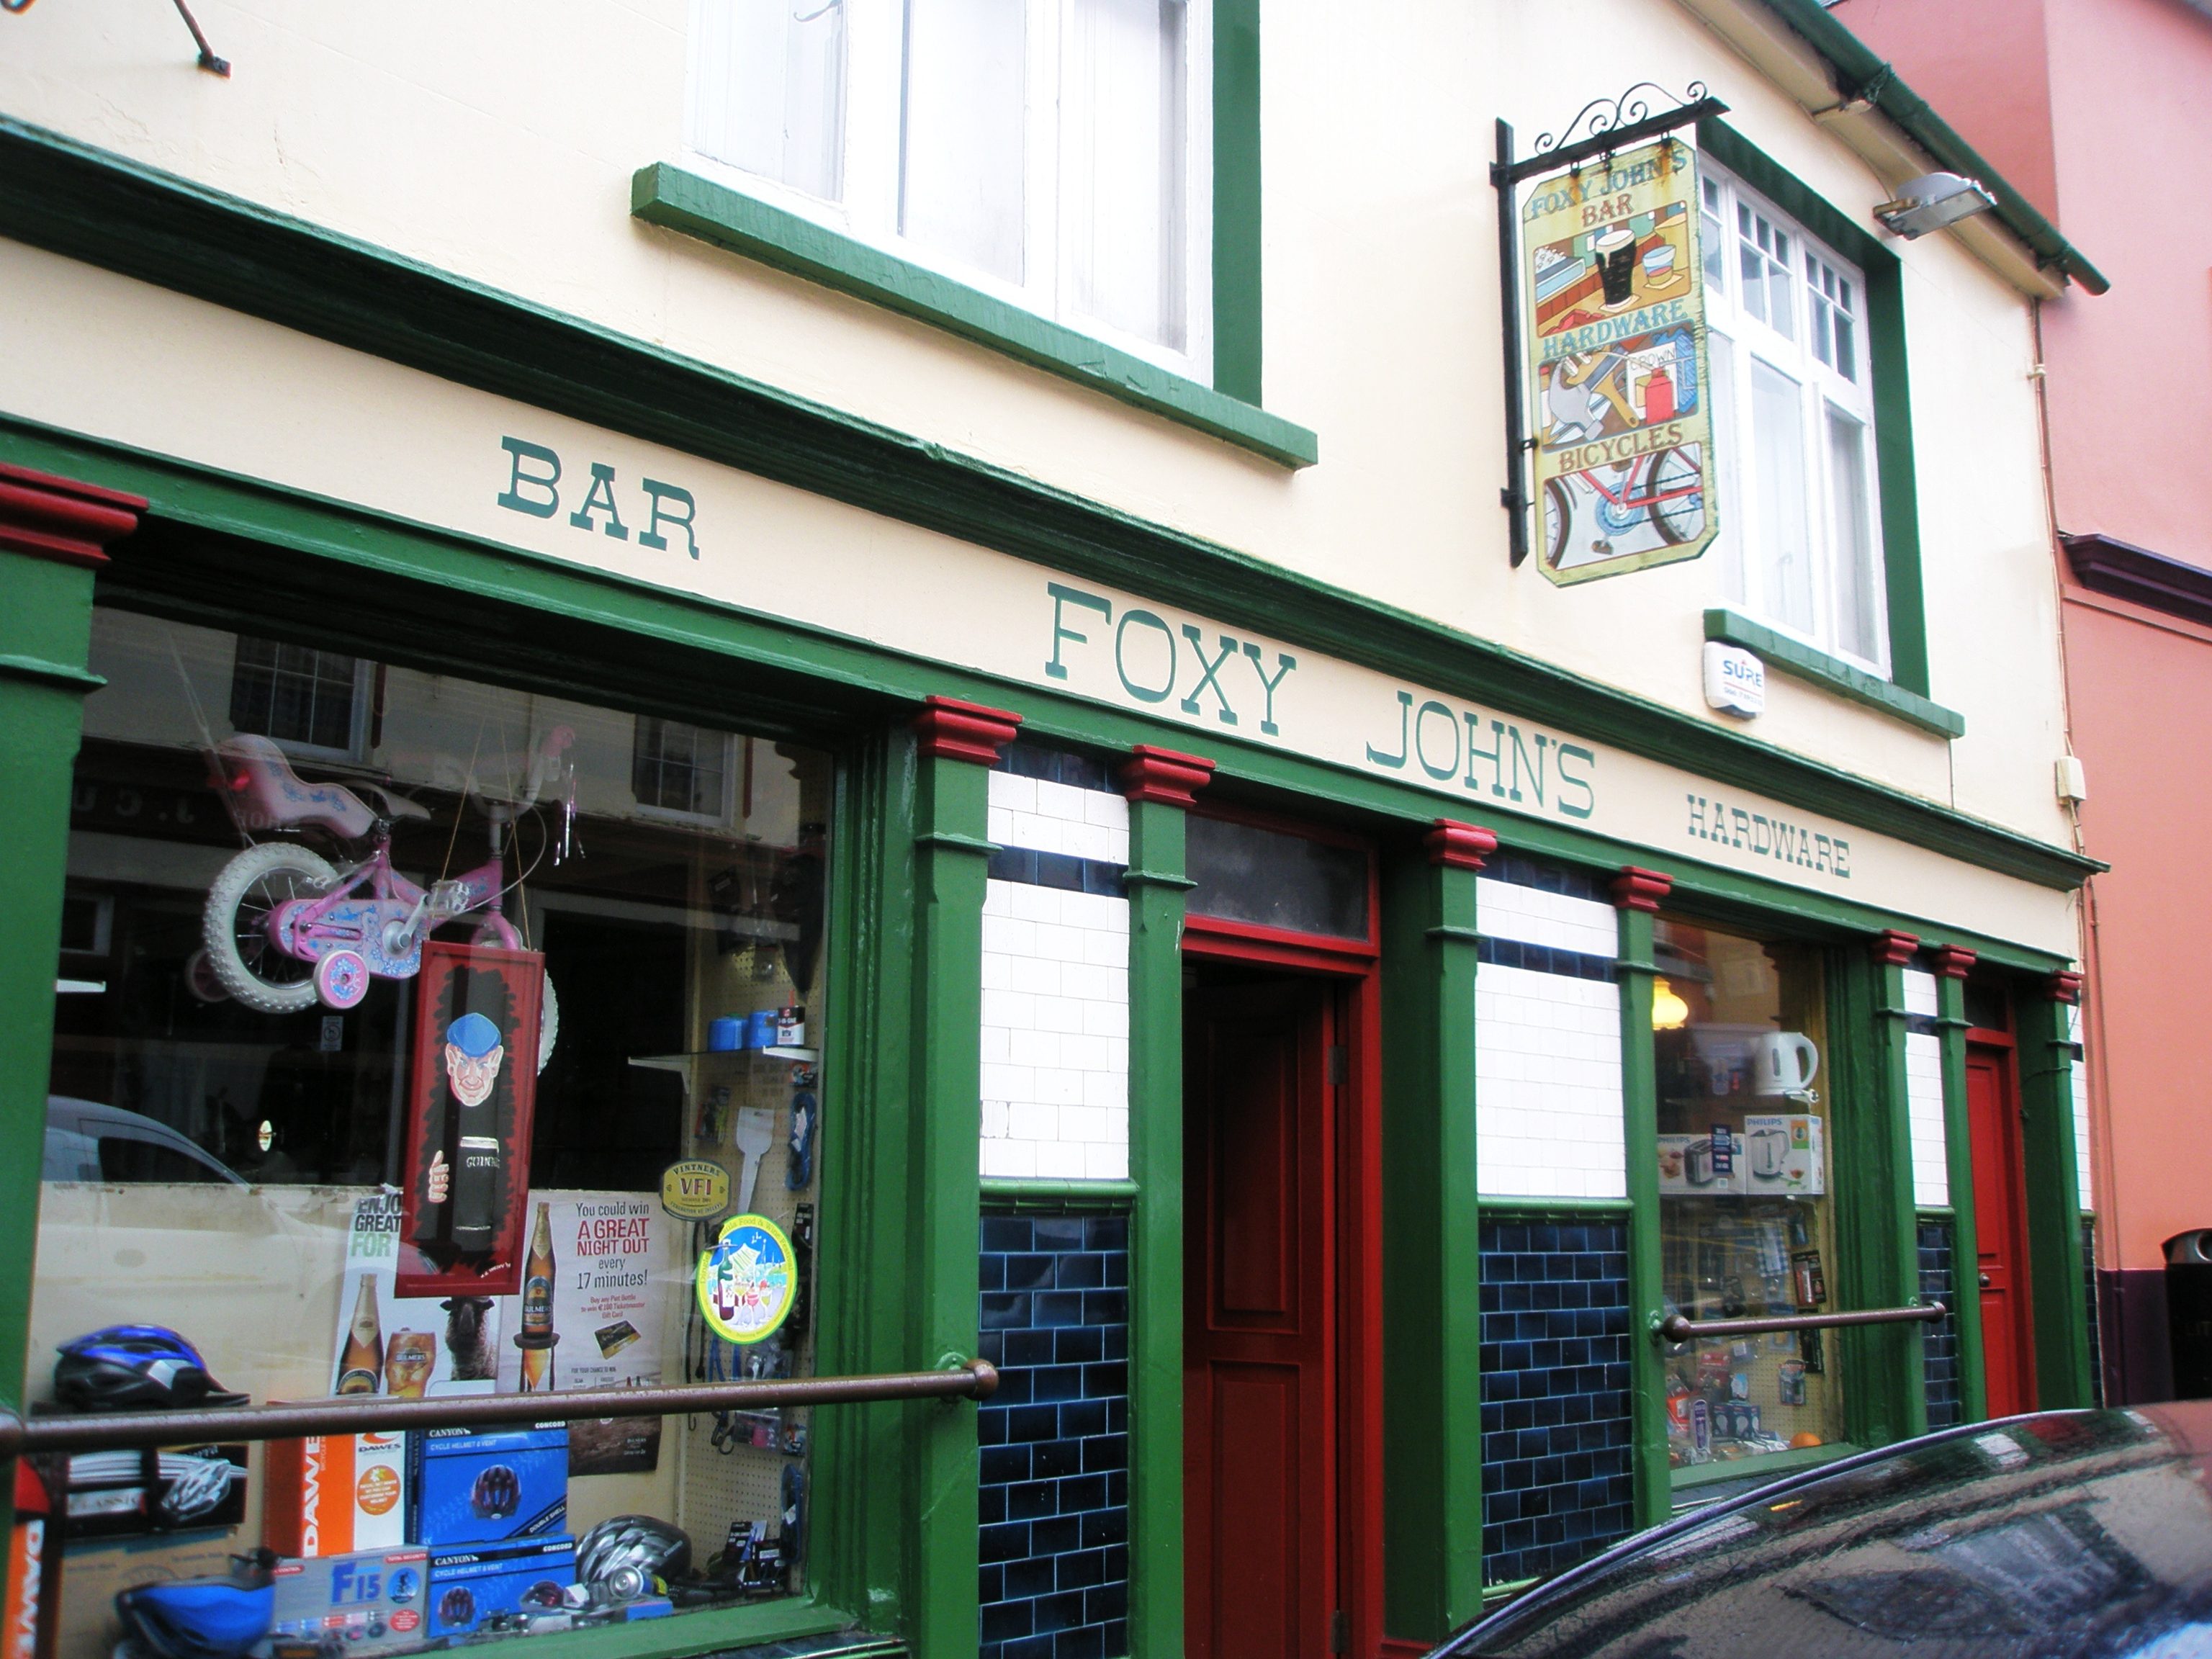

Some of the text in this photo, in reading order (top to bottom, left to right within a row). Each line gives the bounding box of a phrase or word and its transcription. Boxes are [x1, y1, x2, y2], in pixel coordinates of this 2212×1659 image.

[1531, 181, 1591, 219] FOXY
[1582, 194, 1635, 228] BAR
[1543, 298, 1689, 359] HARDWARE
[1559, 423, 1683, 474] BICYCLES
[498, 435, 700, 561] BAR
[1723, 660, 1763, 689] SURE
[1045, 581, 1595, 819] FOXY JOHN'S
[1687, 793, 1851, 879] HARDWARE
[673, 1164, 719, 1177] VINTNERS
[680, 1178, 711, 1195] VFI
[358, 1193, 403, 1215] ENJO
[576, 1200, 649, 1217] You could win
[355, 1214, 402, 1233] GREAT
[577, 1218, 649, 1239] A GREAT
[351, 1233, 392, 1256] FOR
[577, 1238, 649, 1256] NIGHT OUT
[598, 1258, 626, 1271] every
[577, 1269, 648, 1289] 17 minutes!
[429, 1427, 464, 1437] CANYON
[535, 1421, 566, 1429] CONCORD
[359, 1443, 402, 1453] DAWES
[303, 1436, 320, 1557] DAWE
[543, 1542, 573, 1552] CONCORD
[435, 1554, 472, 1566] CANYON
[17, 1519, 45, 1659] DAWE
[332, 1561, 382, 1604] F15
